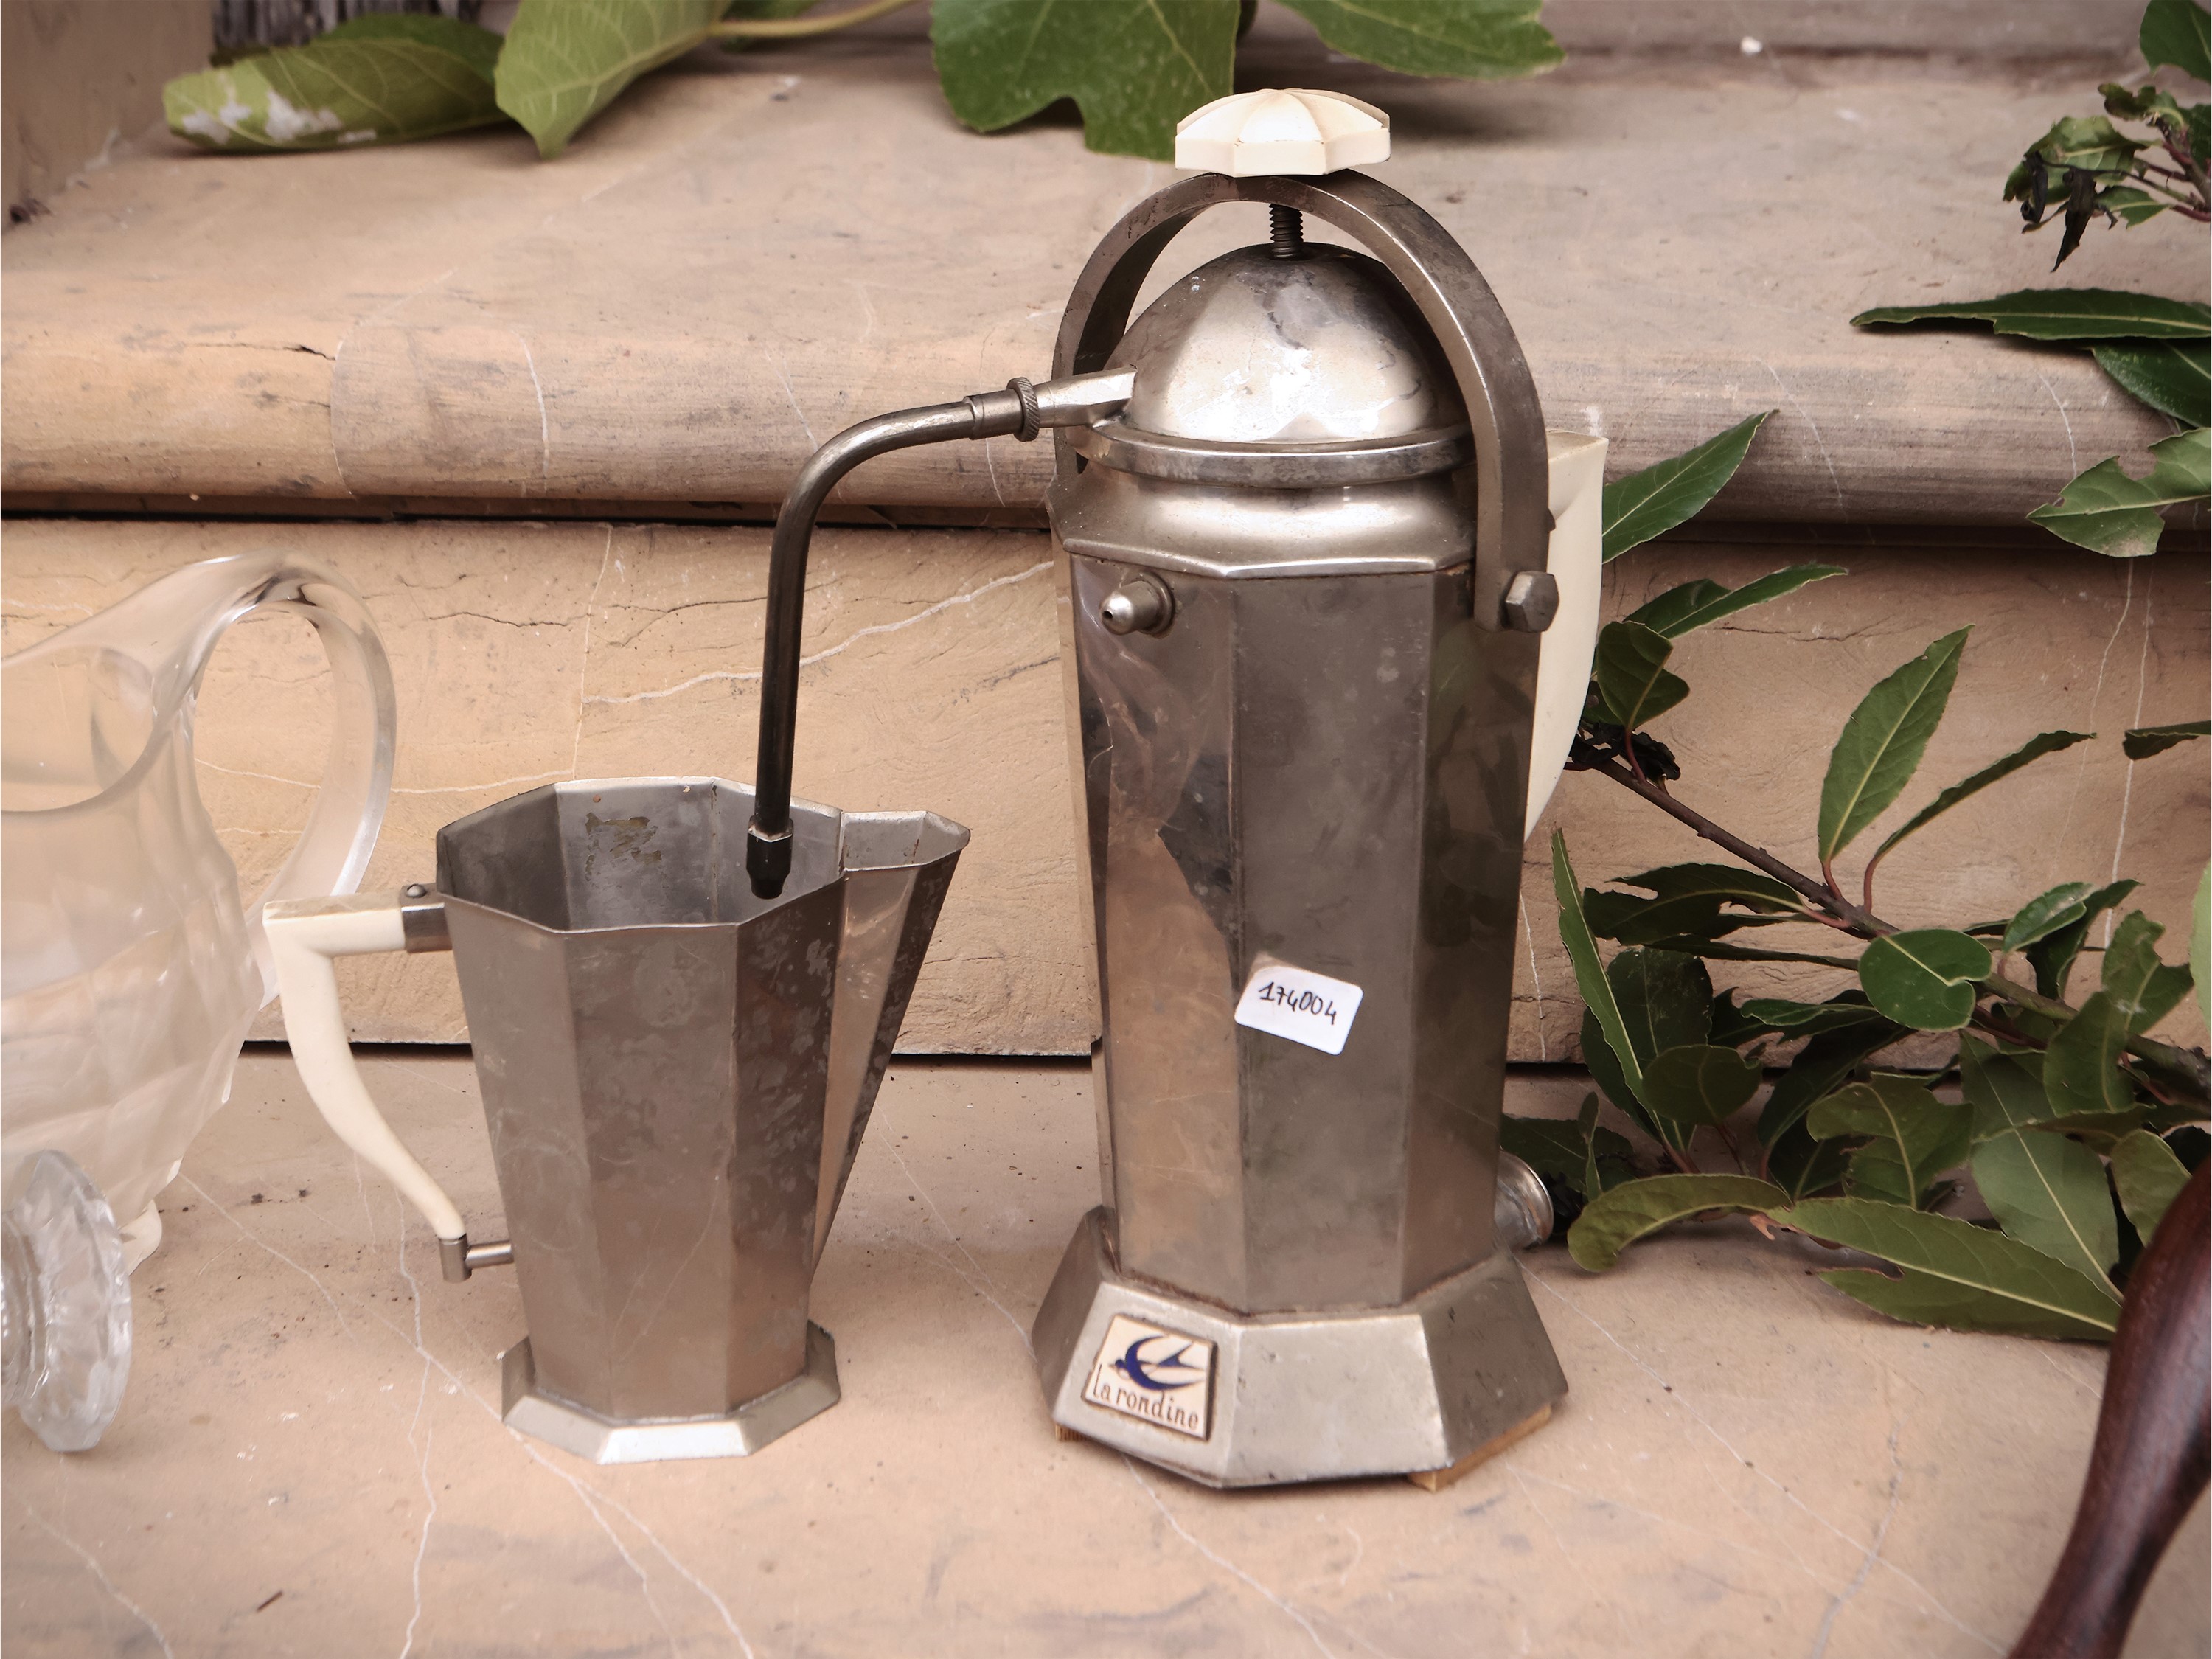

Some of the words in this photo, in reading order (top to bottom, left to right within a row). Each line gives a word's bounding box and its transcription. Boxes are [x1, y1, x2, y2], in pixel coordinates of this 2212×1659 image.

[1259, 981, 1336, 1025] 174004
[1093, 1363, 1111, 1402] la
[1116, 1390, 1198, 1430] rondine
